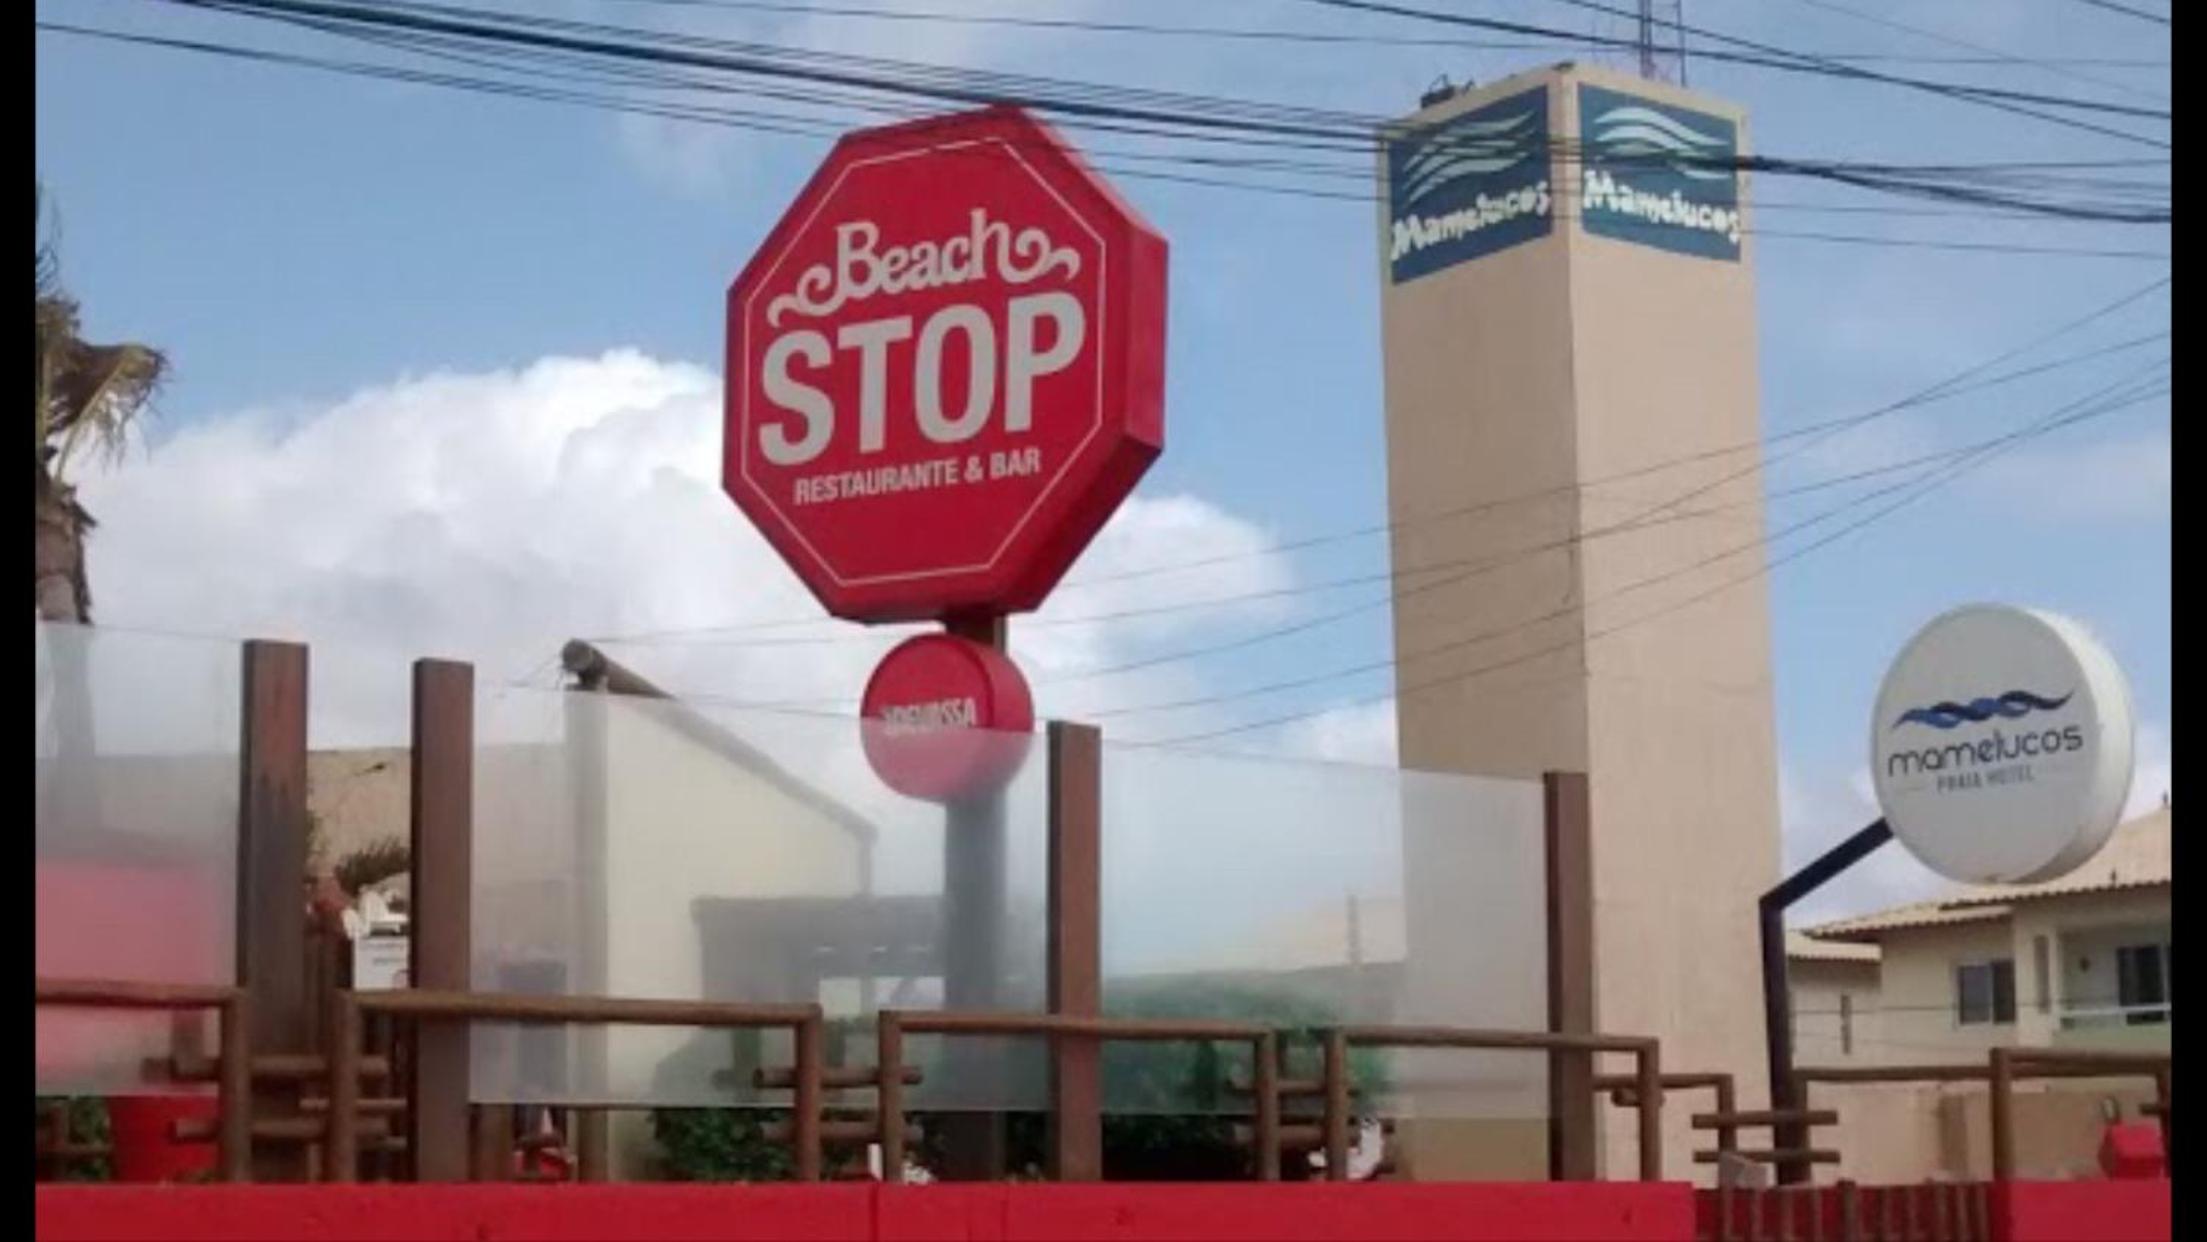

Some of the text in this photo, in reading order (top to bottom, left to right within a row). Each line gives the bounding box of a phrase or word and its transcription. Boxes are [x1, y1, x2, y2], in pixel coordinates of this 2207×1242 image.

[1391, 180, 1551, 261] Mamelucos
[1583, 169, 1741, 244] Mamelucos
[767, 208, 1081, 328] Beach
[758, 291, 1086, 467] STOP
[793, 448, 1042, 505] RESTAURANTE & BAR
[1888, 725, 2084, 778] mamelucos
[1936, 764, 2035, 793] PRAIA HOTEL
